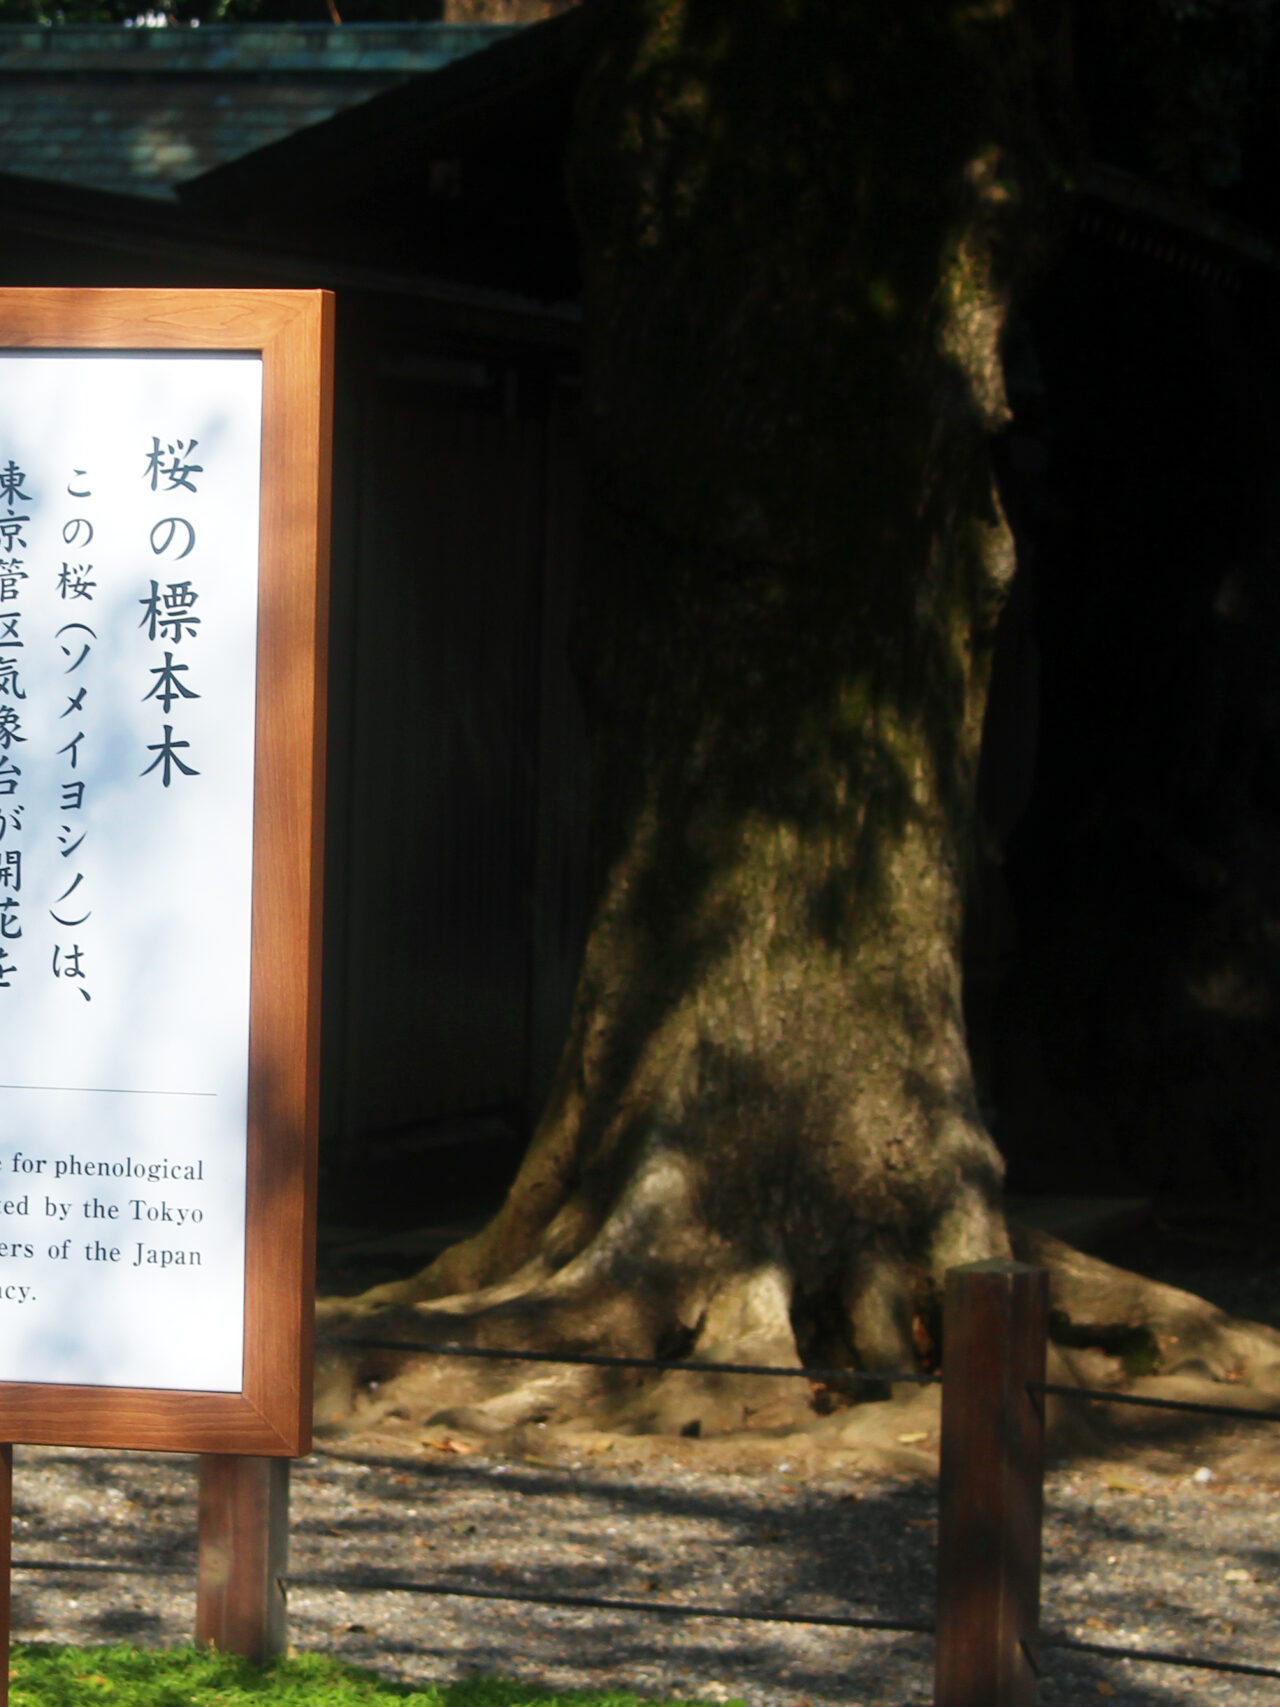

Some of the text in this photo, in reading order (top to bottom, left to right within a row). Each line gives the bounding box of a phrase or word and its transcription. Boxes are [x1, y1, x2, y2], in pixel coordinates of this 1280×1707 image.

[137, 435, 204, 789] 桜の標本木
[11, 1151, 48, 1174] for
[54, 1154, 204, 1183] phenological
[44, 1195, 73, 1222] by
[82, 1197, 120, 1220] the
[128, 1199, 204, 1227] Tokyo
[47, 1238, 72, 1260] of
[84, 1240, 121, 1263] the
[132, 1242, 202, 1269] Japan
